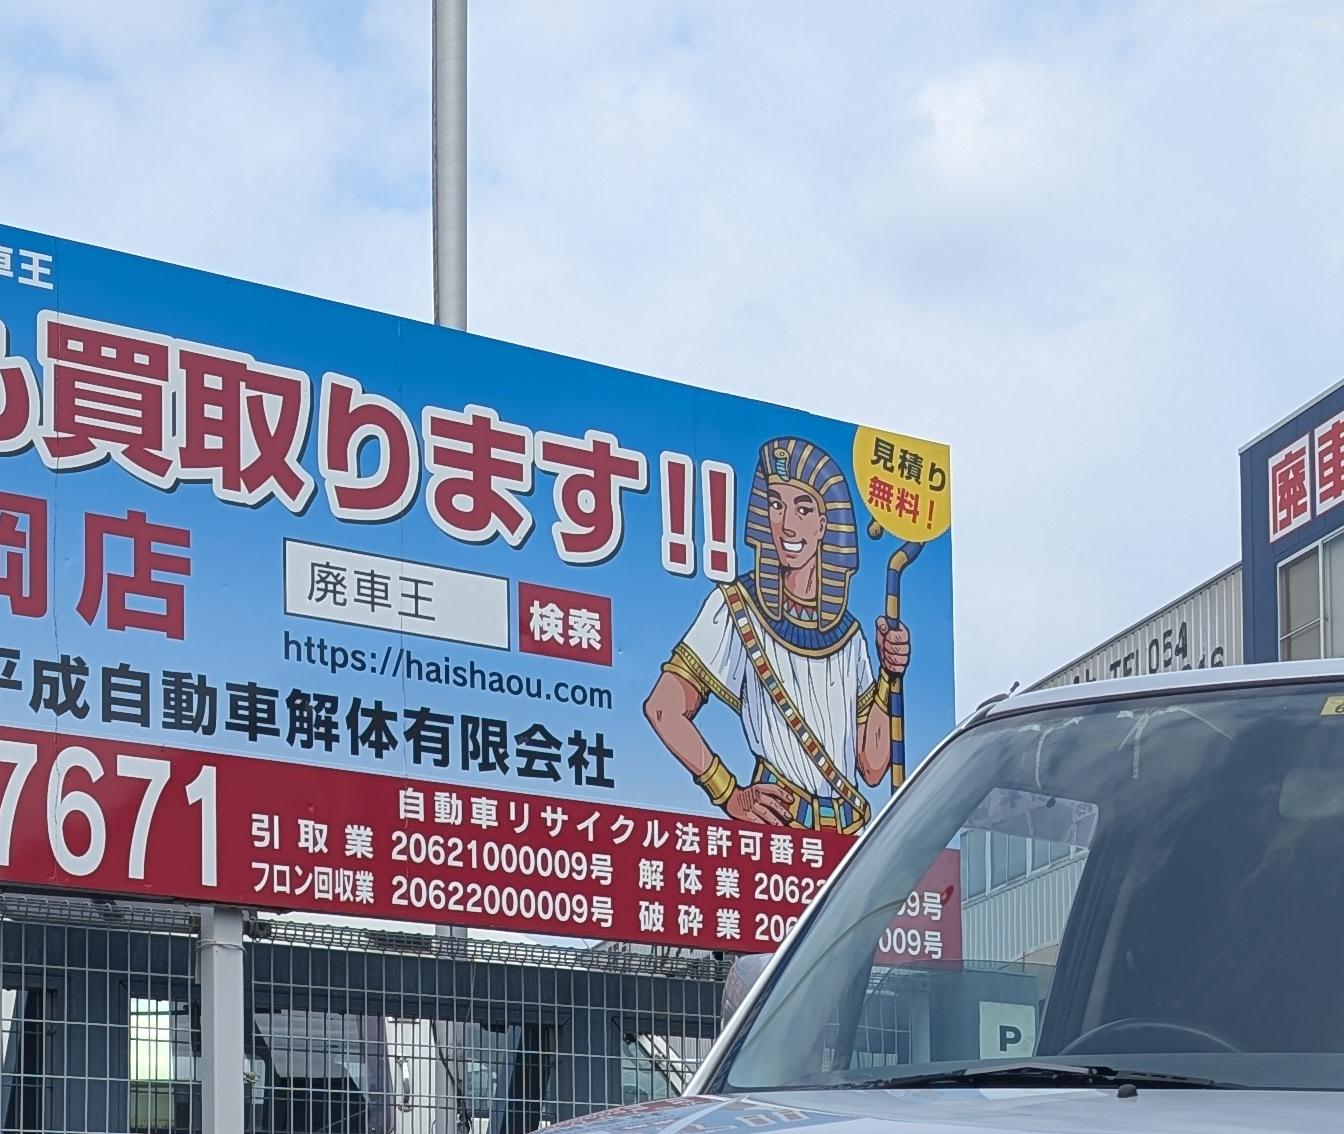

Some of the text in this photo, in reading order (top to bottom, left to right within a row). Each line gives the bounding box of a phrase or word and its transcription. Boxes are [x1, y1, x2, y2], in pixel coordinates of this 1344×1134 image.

[867, 475, 935, 531] 無料！
[870, 436, 946, 492] 見積り
[306, 558, 603, 653] 廃車王 検索
[283, 629, 613, 710] https://haishaou.com
[1148, 621, 1188, 675] 054
[250, 813, 374, 860] 引取業
[391, 831, 613, 886] 20621000009号
[637, 858, 741, 902] 解体業
[398, 789, 825, 869] 自動車リサイクル法許可番号
[250, 861, 375, 905] フロン回収業
[391, 875, 614, 929] 20622000009号
[638, 899, 741, 942] 破砕業
[999, 1025, 1022, 1052] P
